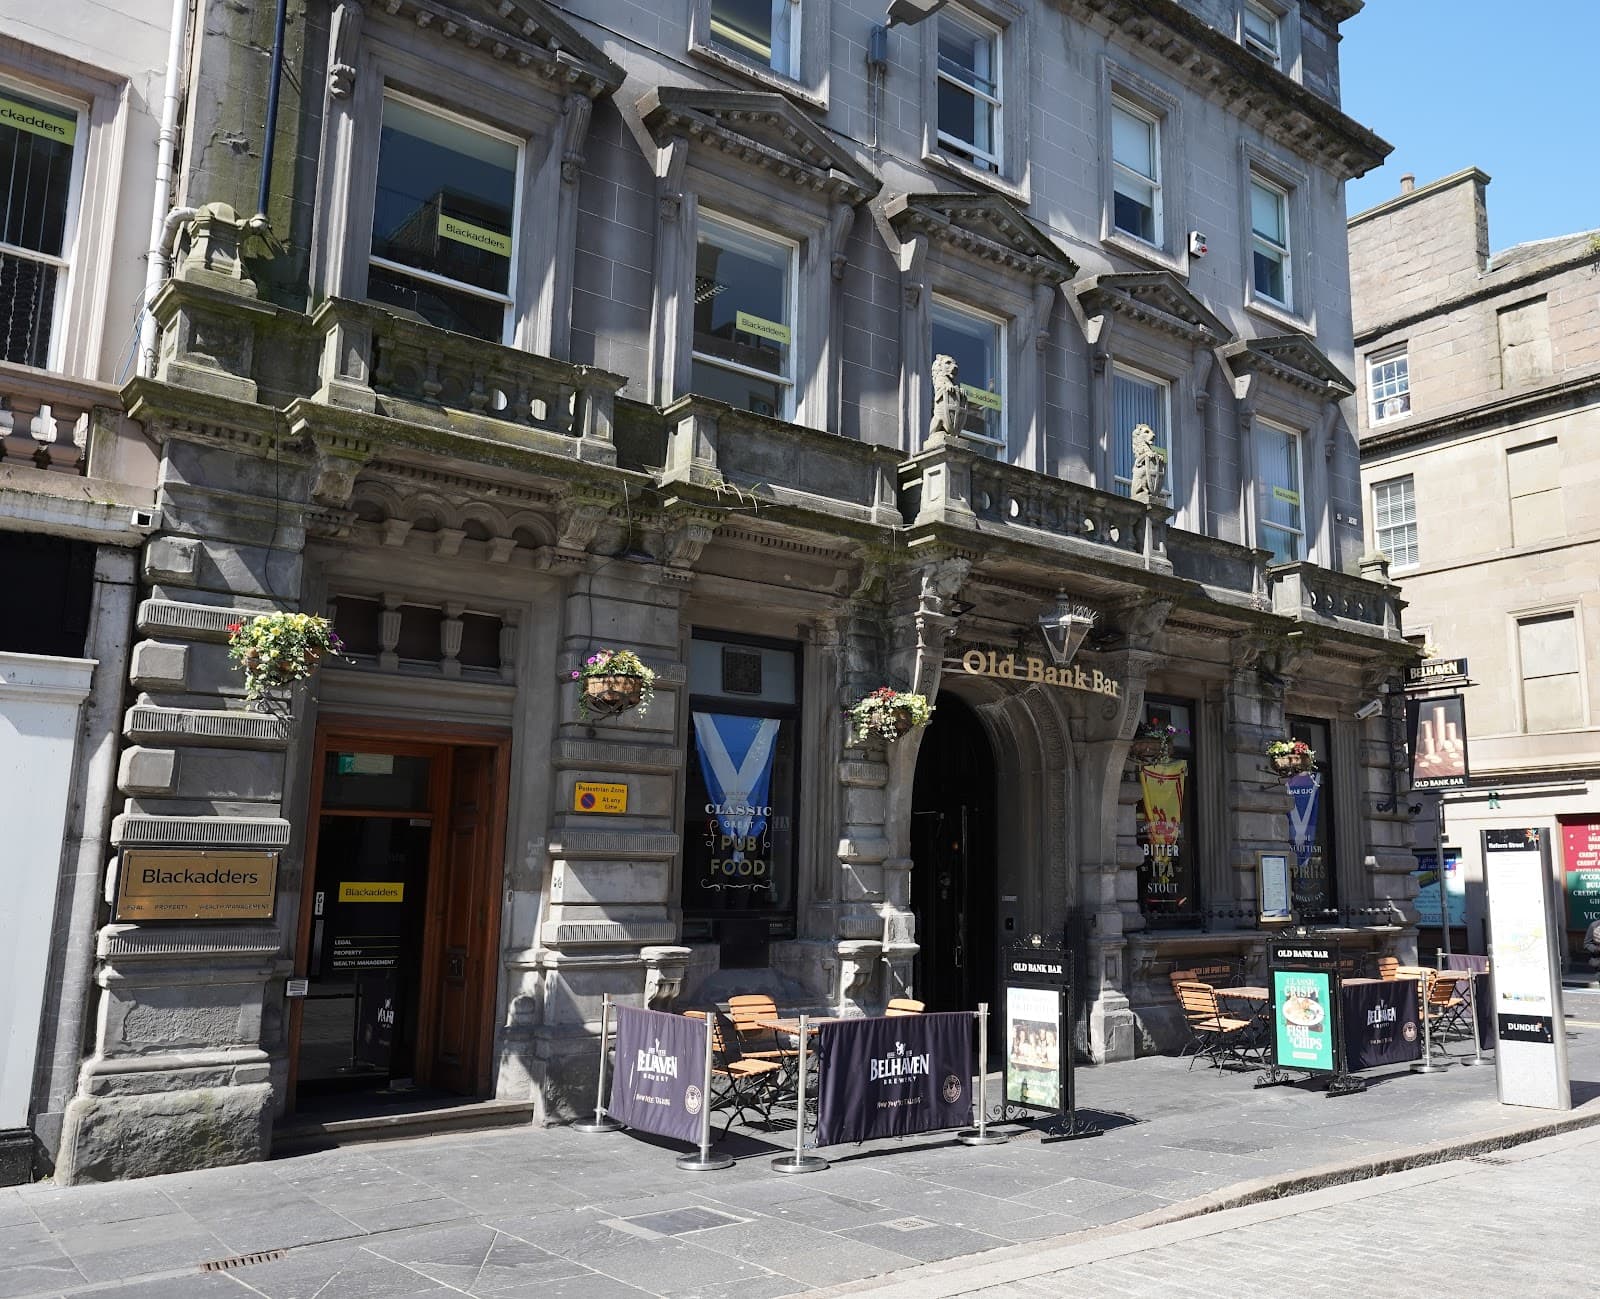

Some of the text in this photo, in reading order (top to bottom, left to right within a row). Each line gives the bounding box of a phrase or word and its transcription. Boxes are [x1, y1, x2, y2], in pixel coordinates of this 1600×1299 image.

[446, 223, 505, 249] Blackadders
[741, 318, 786, 338] Blackadders
[962, 650, 1119, 697] Old Bank Bar
[1410, 661, 1458, 680] BELHAVEN
[1414, 778, 1464, 788] OLD BANK BAR
[704, 803, 772, 817] CLASSIC
[720, 835, 757, 852] PUB
[1143, 843, 1179, 857] BITTER
[710, 858, 766, 876] FOOD
[1152, 861, 1174, 877] IPA
[142, 868, 258, 884] Blackadders
[345, 887, 399, 897] Blackadders
[1147, 882, 1179, 894] STOUT
[1573, 889, 1598, 897] CREDIT
[1277, 949, 1328, 959] OLD BANK BAR
[1013, 962, 1063, 974] OLD BANK BAR
[1284, 985, 1320, 998] CRISPY
[1286, 1024, 1309, 1037] FISH
[1507, 1022, 1541, 1033] DUNDEE
[1293, 1037, 1323, 1050] CHIPS
[870, 1053, 930, 1081] BELHAVEN
